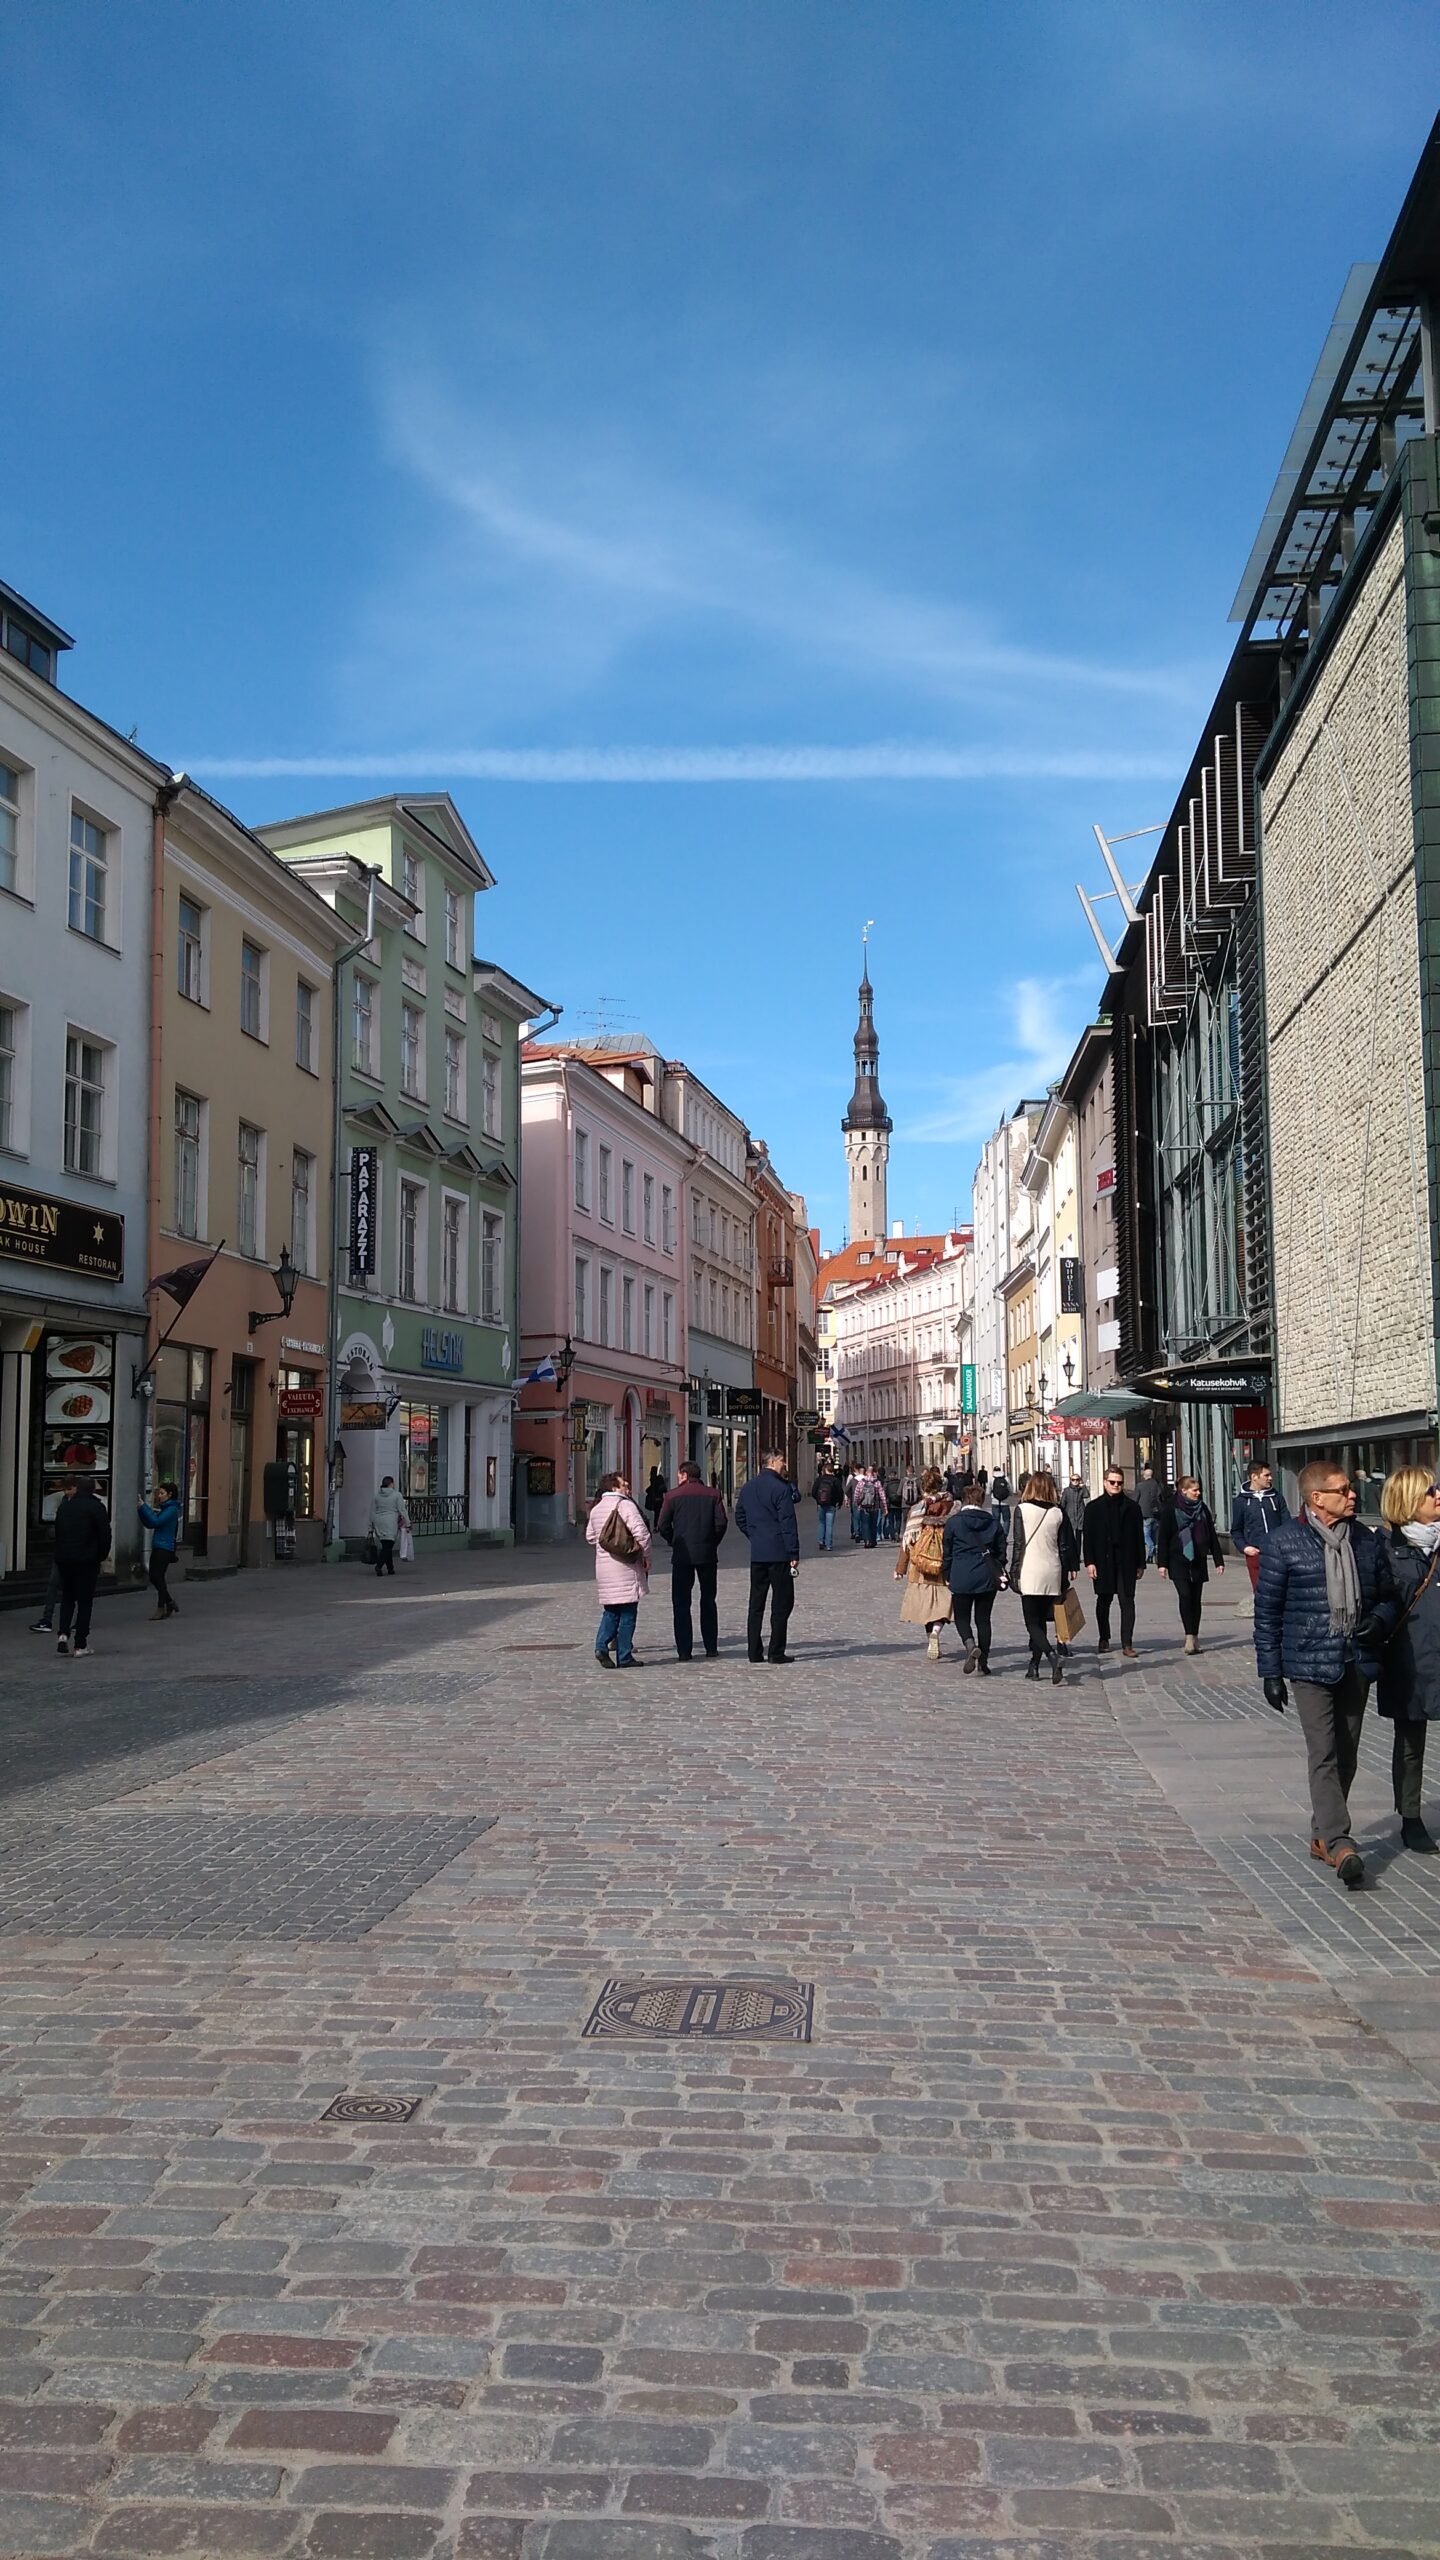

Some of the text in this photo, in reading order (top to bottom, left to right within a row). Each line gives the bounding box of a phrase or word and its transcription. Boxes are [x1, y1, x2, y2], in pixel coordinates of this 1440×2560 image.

[357, 1153, 370, 1269] PAPARAZZI
[15, 1239, 46, 1255] HOUSE
[79, 1253, 117, 1271] RESTORAN
[345, 1346, 375, 1371] ESTORAN
[965, 1368, 973, 1410] SALAMANDER
[1190, 1378, 1247, 1387] Katusekohvik
